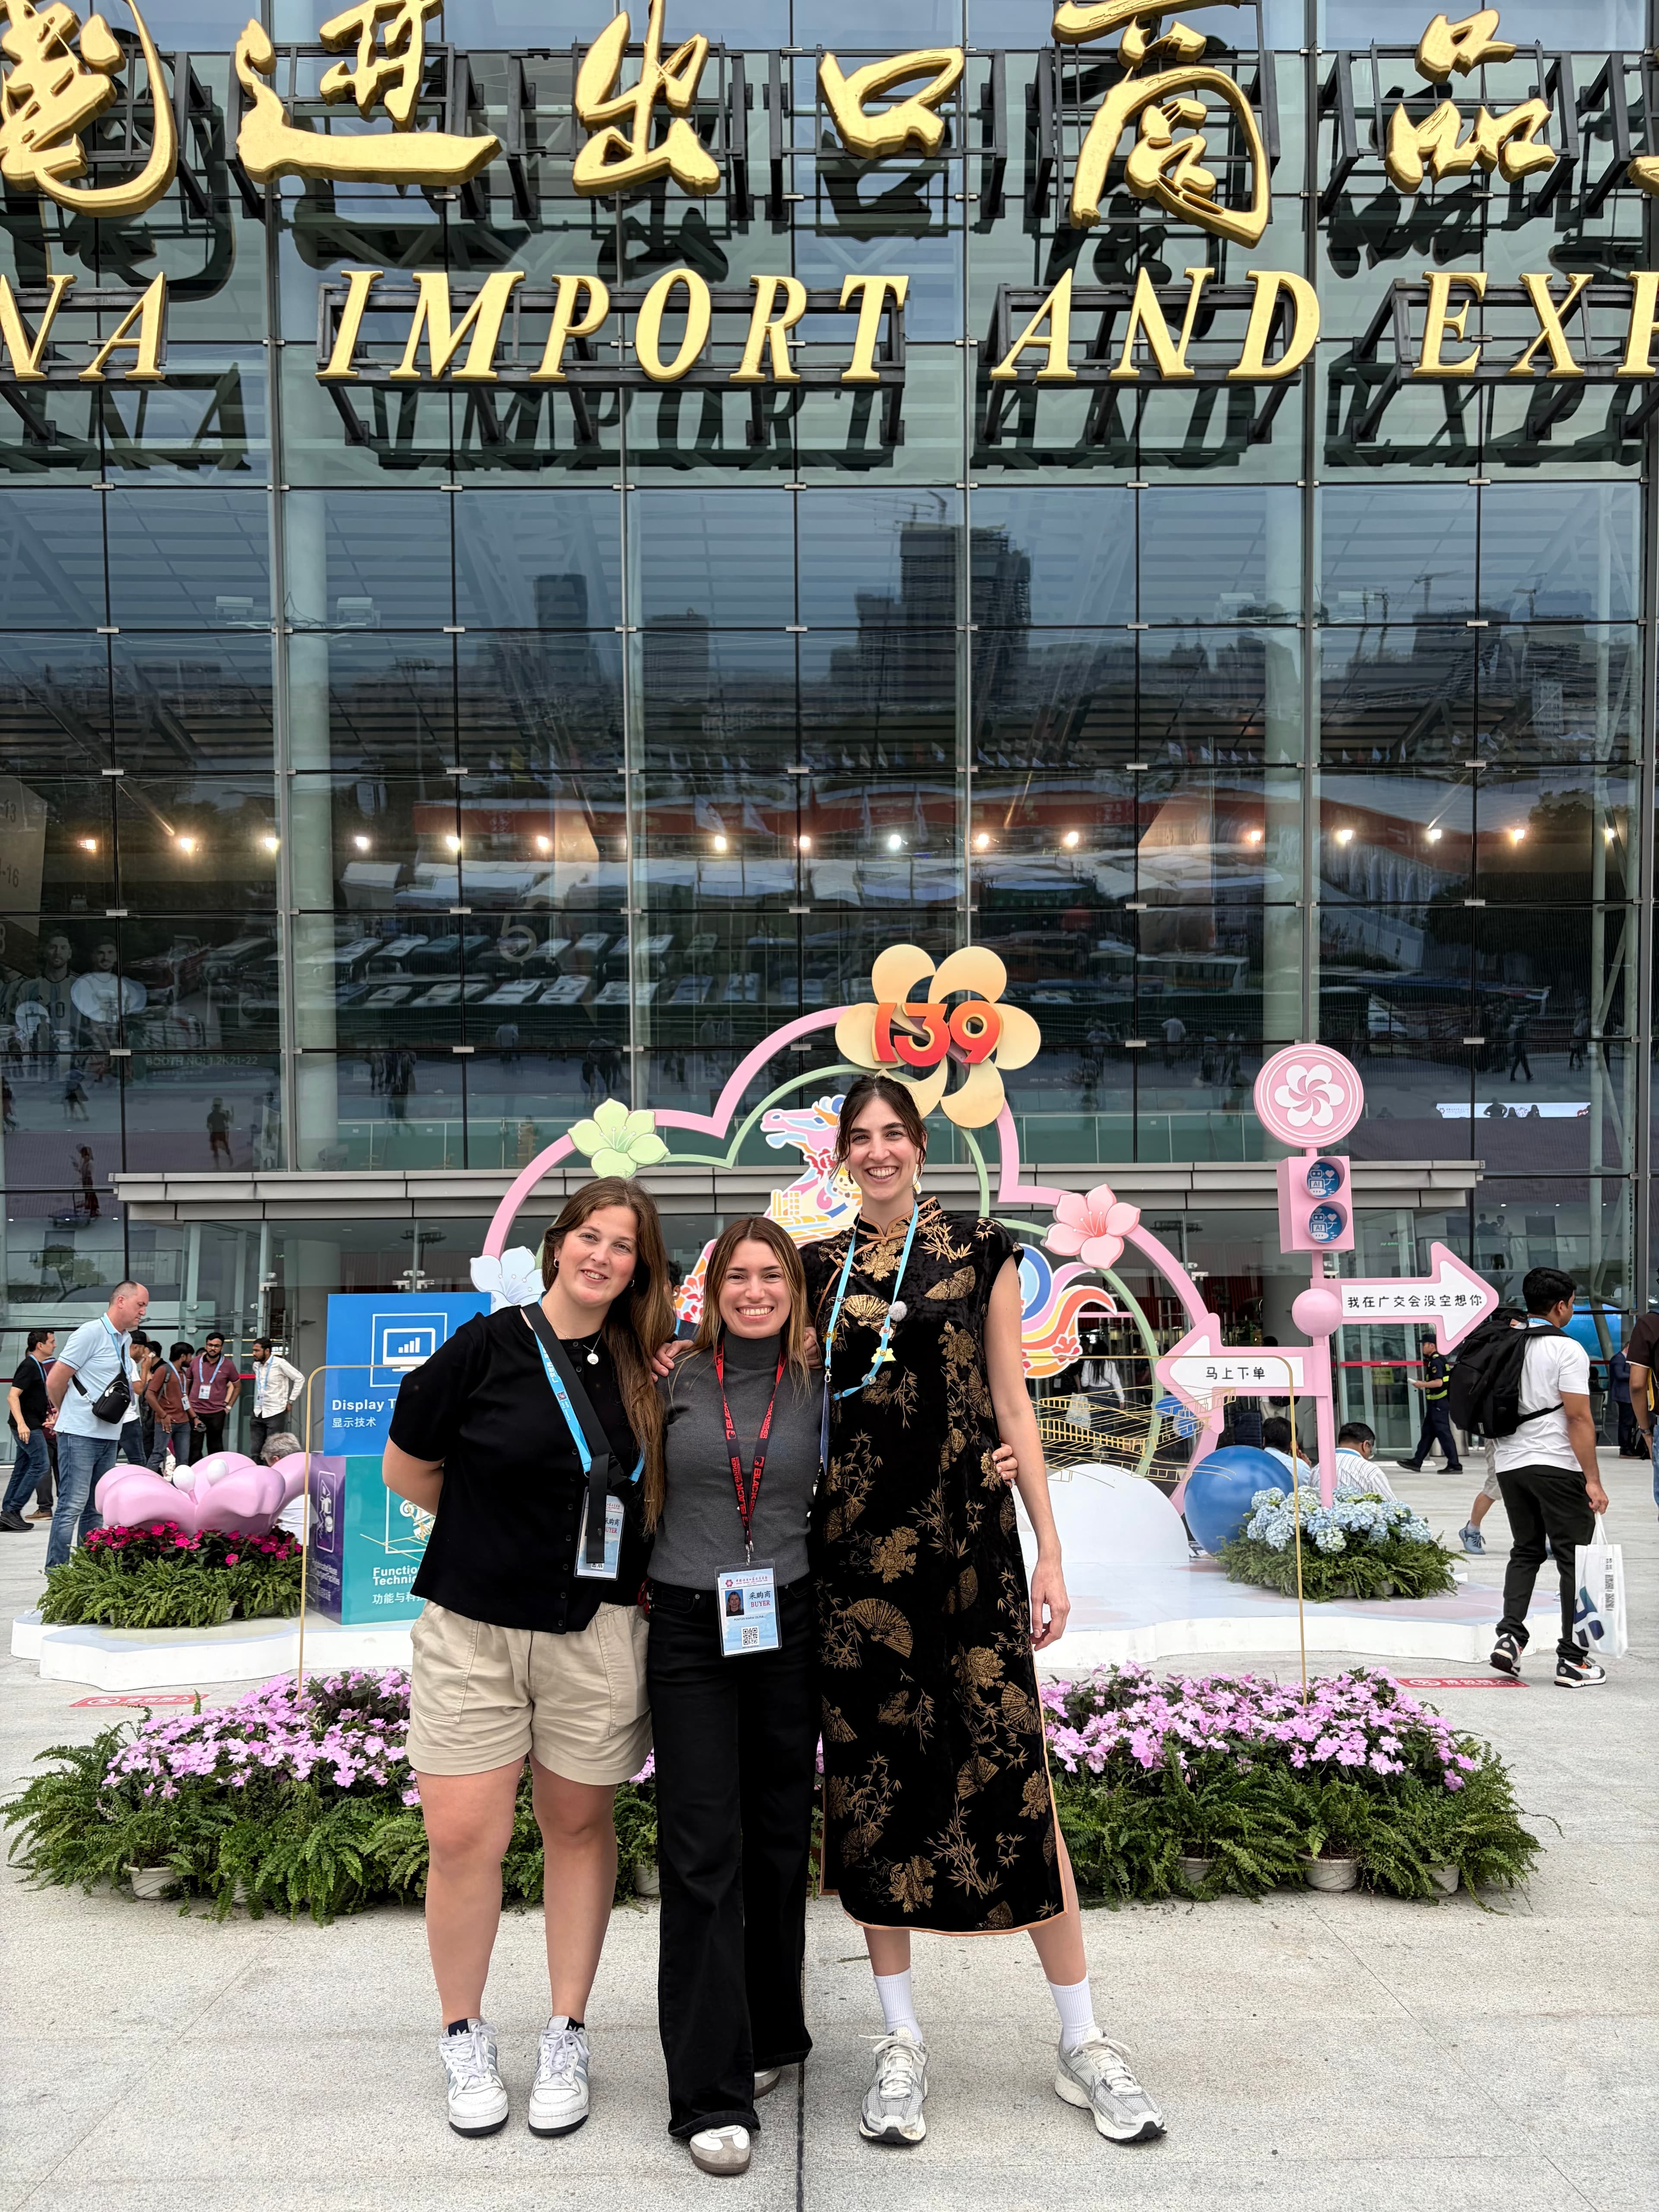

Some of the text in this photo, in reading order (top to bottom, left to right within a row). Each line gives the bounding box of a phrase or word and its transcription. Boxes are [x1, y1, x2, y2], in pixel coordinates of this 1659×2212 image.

[315, 268, 909, 383] IMPORT
[990, 268, 1321, 382] AND
[871, 1001, 1004, 1068] 139
[145, 1057, 184, 1066] BOOTH
[1348, 1294, 1483, 1308] 我在广交会没空想你
[1205, 1366, 1265, 1380] 马上下单
[332, 1399, 385, 1413] Display
[332, 1416, 377, 1428] 显示技术
[731, 1456, 740, 1483] PANTHER
[751, 1468, 762, 1500] BLACK
[736, 1482, 747, 1515] BLACK
[373, 1565, 420, 1577] Functio
[372, 1592, 423, 1605] 功能与科
[749, 1590, 771, 1600] 采购商
